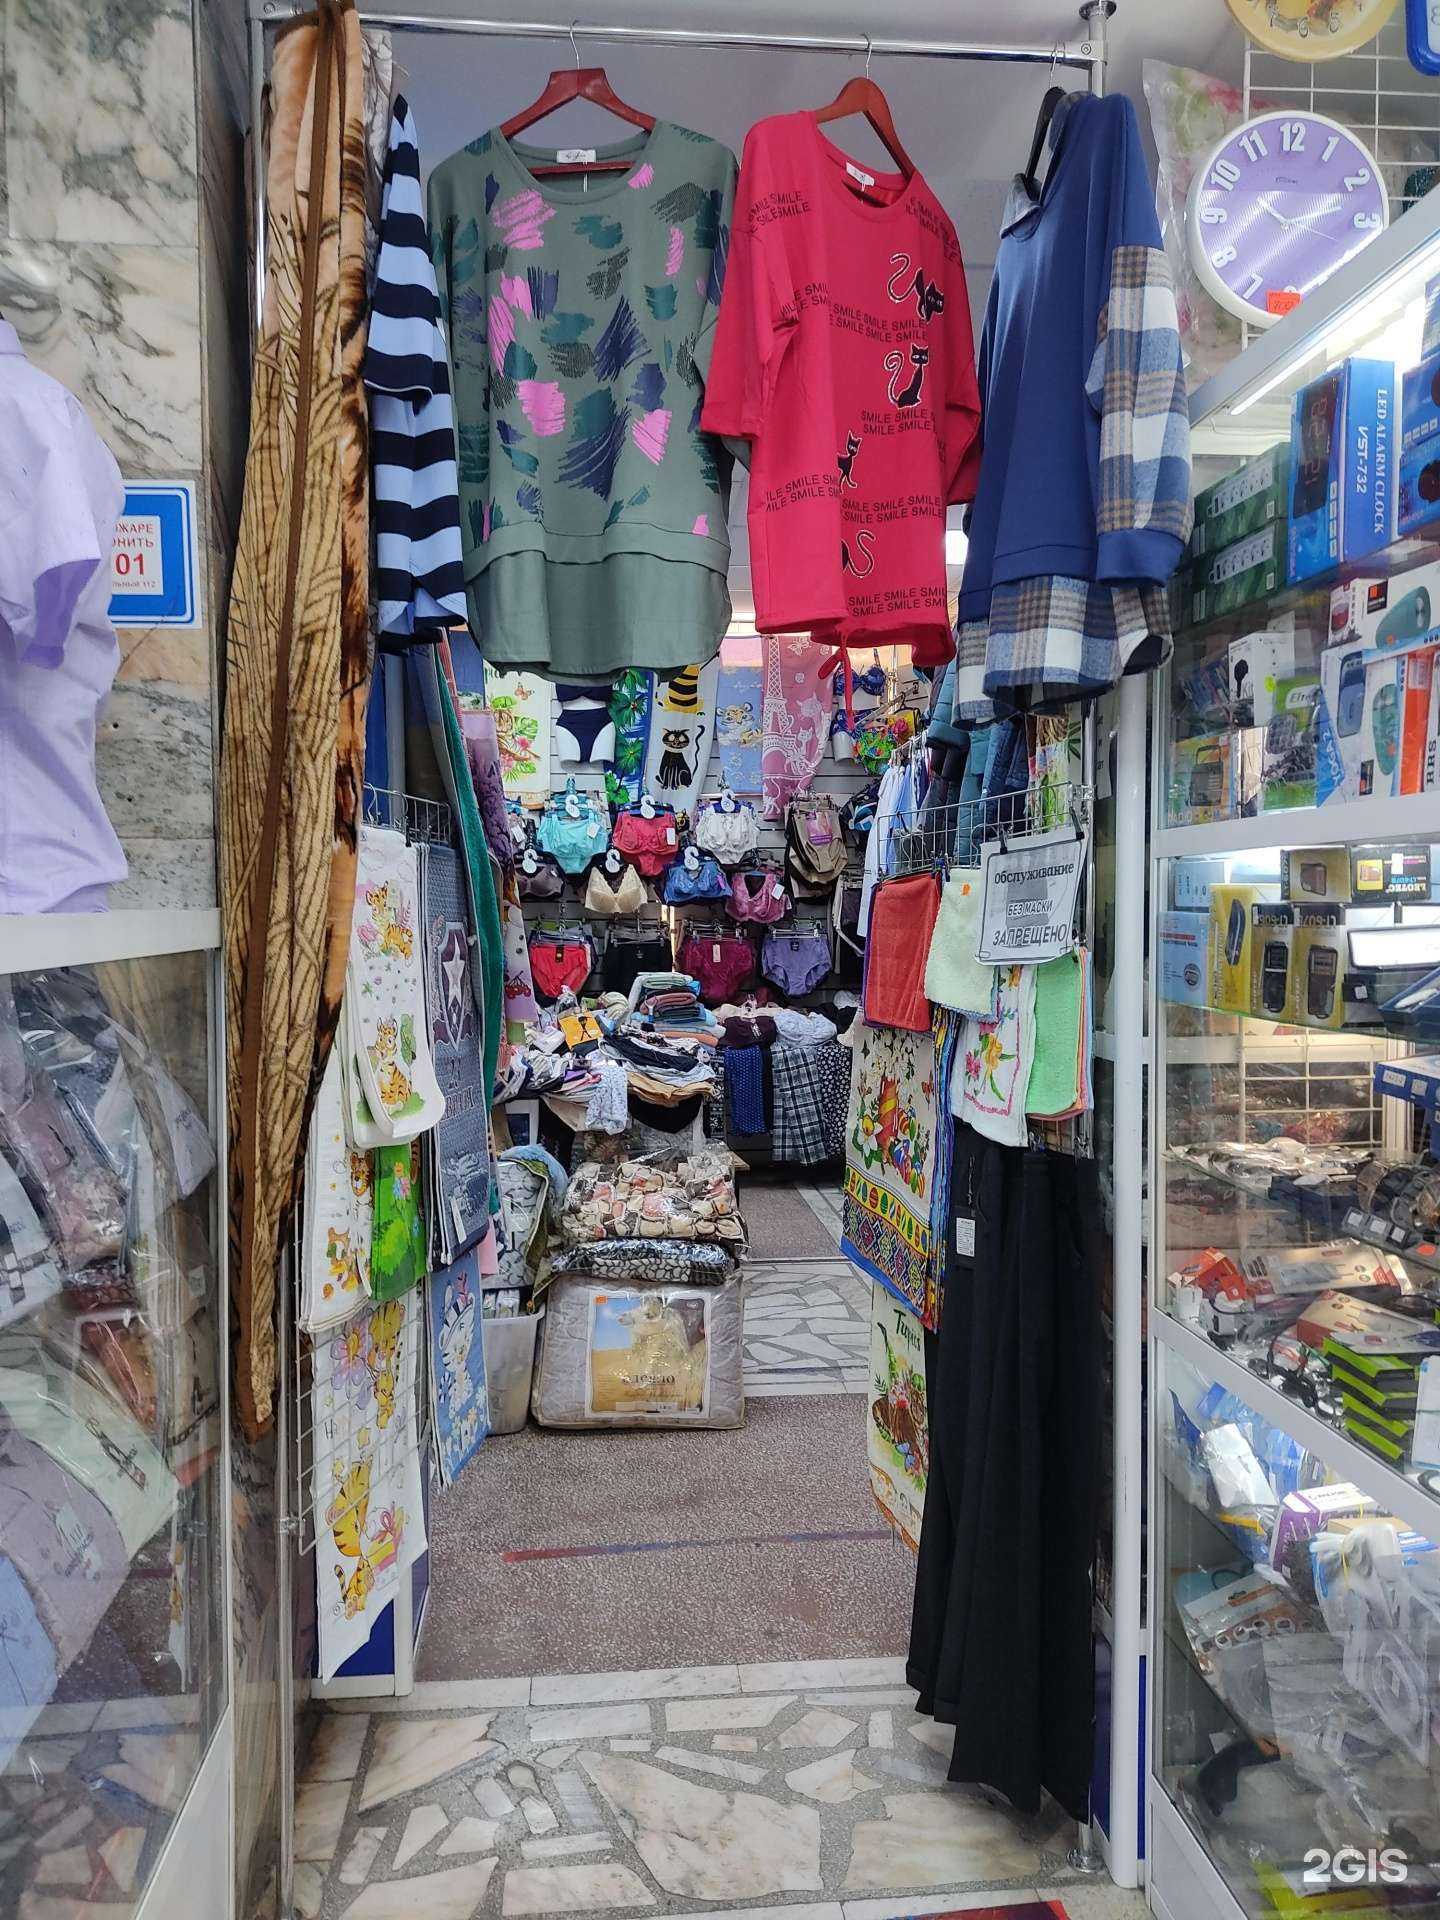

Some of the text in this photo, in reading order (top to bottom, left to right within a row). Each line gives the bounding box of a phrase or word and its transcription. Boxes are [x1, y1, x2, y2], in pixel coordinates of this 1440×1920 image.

[1238, 129, 1268, 162] 11
[1279, 122, 1306, 152] 12
[1321, 135, 1339, 162] 1
[1209, 159, 1241, 192] 10
[1343, 167, 1370, 192] 2
[1201, 207, 1227, 224] 9
[1353, 212, 1381, 229] 3
[1211, 246, 1236, 269] 8
[1243, 273, 1264, 299] 7
[833, 303, 927, 331] SMILE SMILE SMILE
[836, 318, 928, 343] SMILE SMILE SMILE
[861, 408, 928, 424] SMILE SMILE
[863, 420, 932, 435] SMILE SMILE
[1356, 425, 1369, 494] VST-732
[1374, 389, 1388, 535] LED ALARM CLOCK
[785, 474, 820, 492] SMILE
[790, 487, 824, 504] SMILE
[873, 497, 905, 512] SMILE
[908, 495, 941, 506] SMILE
[843, 506, 944, 524] SMILE SMILE SMILE
[115, 523, 154, 533] ЖАРЕ
[115, 553, 145, 576] 01
[849, 587, 946, 606] SMILE SMILE SMIL
[853, 597, 946, 618] SMILE SMILE SMI
[1007, 900, 1053, 916] БЕЗ МАСКИ
[992, 924, 1068, 946] ЗАПРЕЩЕНО
